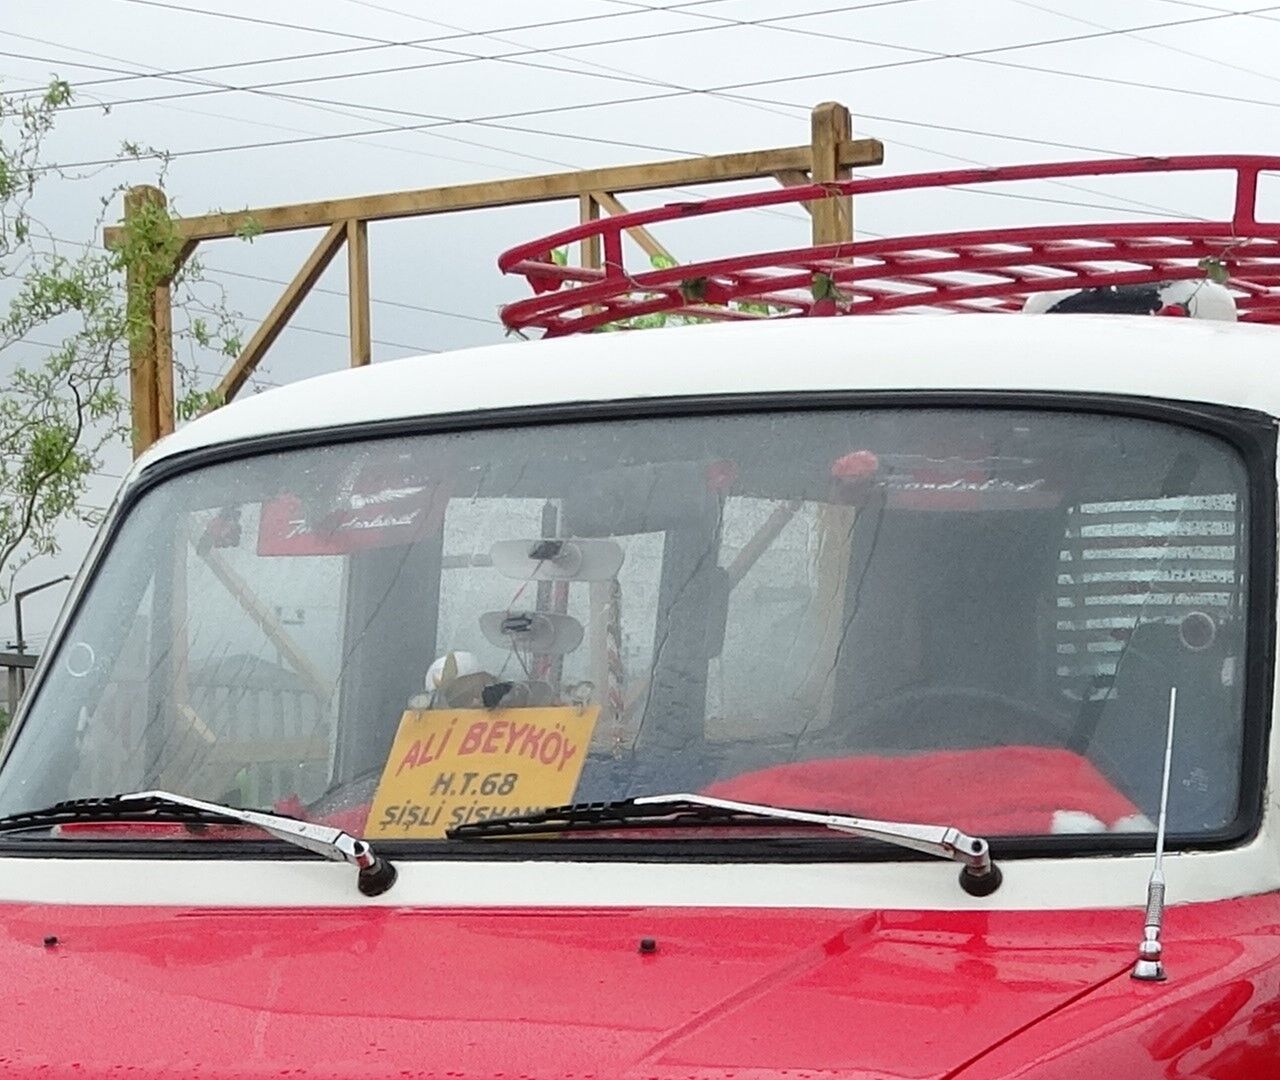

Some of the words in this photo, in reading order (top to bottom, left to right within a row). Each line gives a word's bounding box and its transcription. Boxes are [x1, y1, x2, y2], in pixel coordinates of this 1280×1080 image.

[396, 718, 458, 776] ALİ
[457, 721, 577, 772] BEYKÖY
[430, 772, 518, 796] H.T.68
[379, 800, 446, 831] ŞİŞLİ
